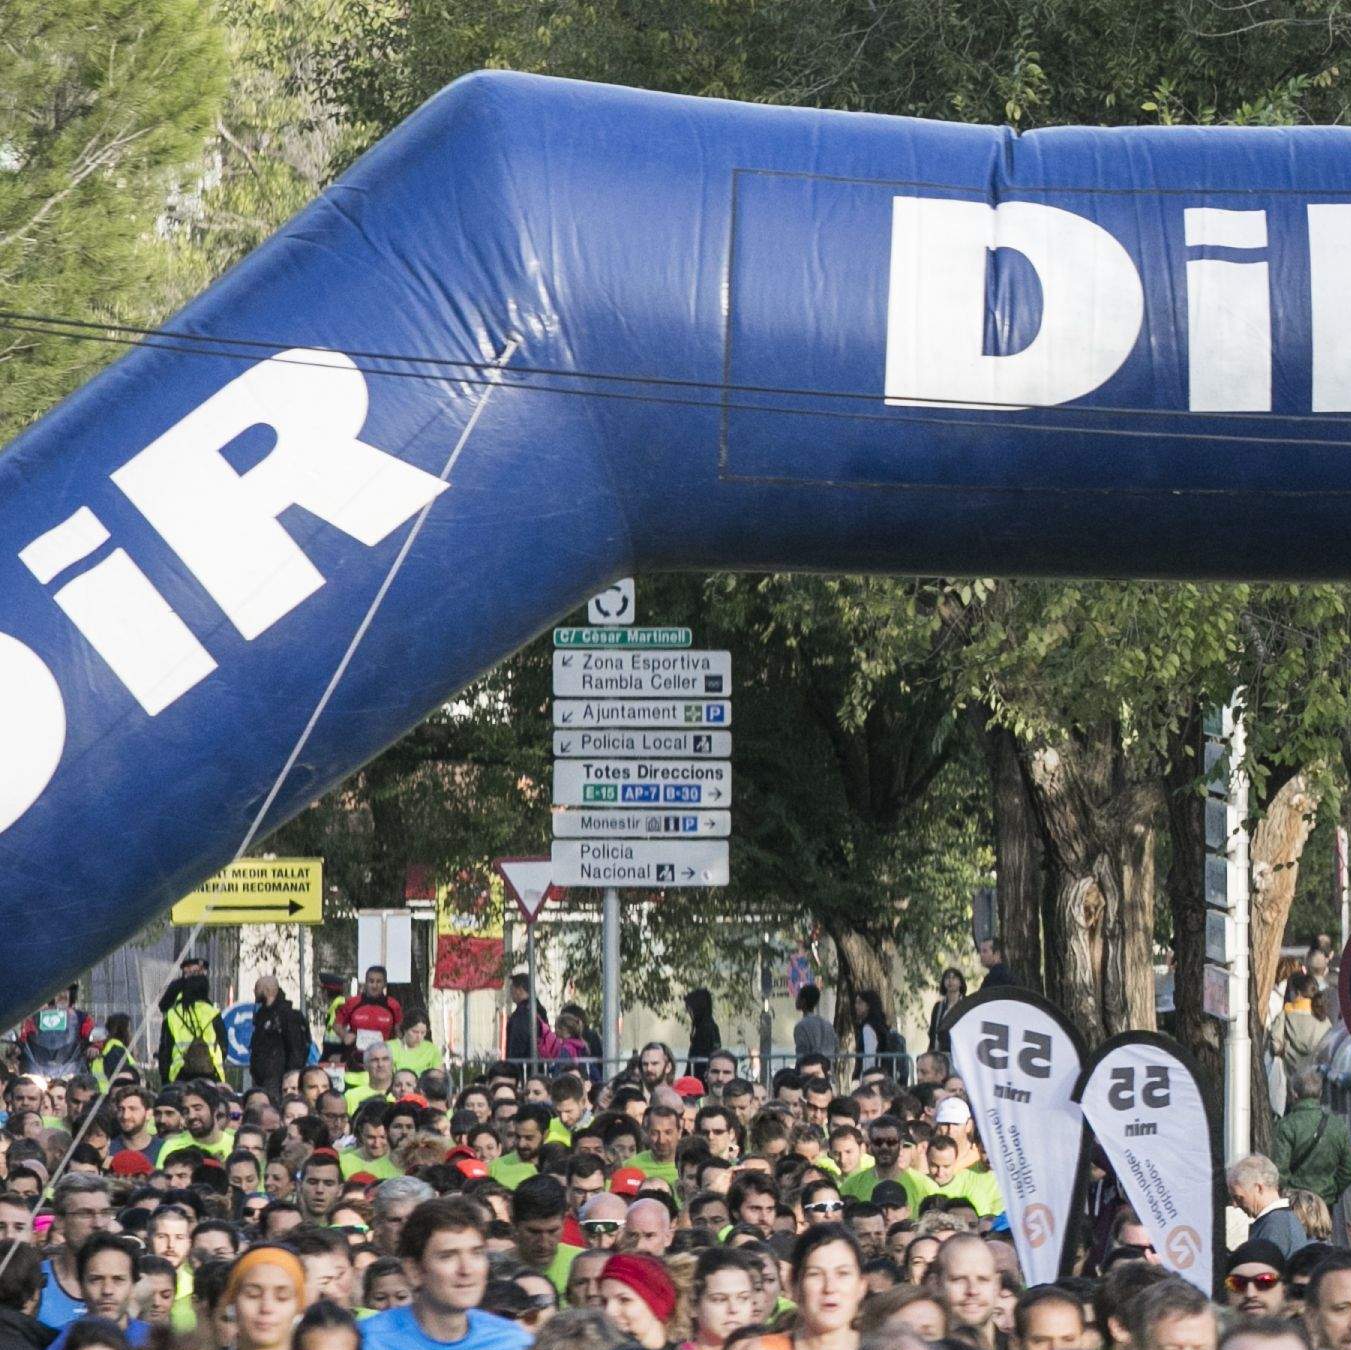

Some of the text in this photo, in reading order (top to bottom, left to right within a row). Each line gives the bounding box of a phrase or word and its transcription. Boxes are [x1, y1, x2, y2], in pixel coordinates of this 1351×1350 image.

[0, 347, 451, 834] iR
[560, 629, 575, 643] C/
[627, 629, 686, 643] Martinell
[582, 654, 710, 672] Zona Esportiva
[582, 675, 643, 690] Rambla
[650, 674, 697, 690] Celler
[582, 704, 677, 722] Ajuntament
[642, 735, 687, 749] Local
[582, 764, 724, 780] Totes Direccions
[581, 816, 640, 830] Monestir
[232, 868, 268, 878] MEDIR
[272, 868, 311, 878] TALLAT
[580, 863, 650, 879] Nacional
[242, 882, 311, 893] RECOMANAT
